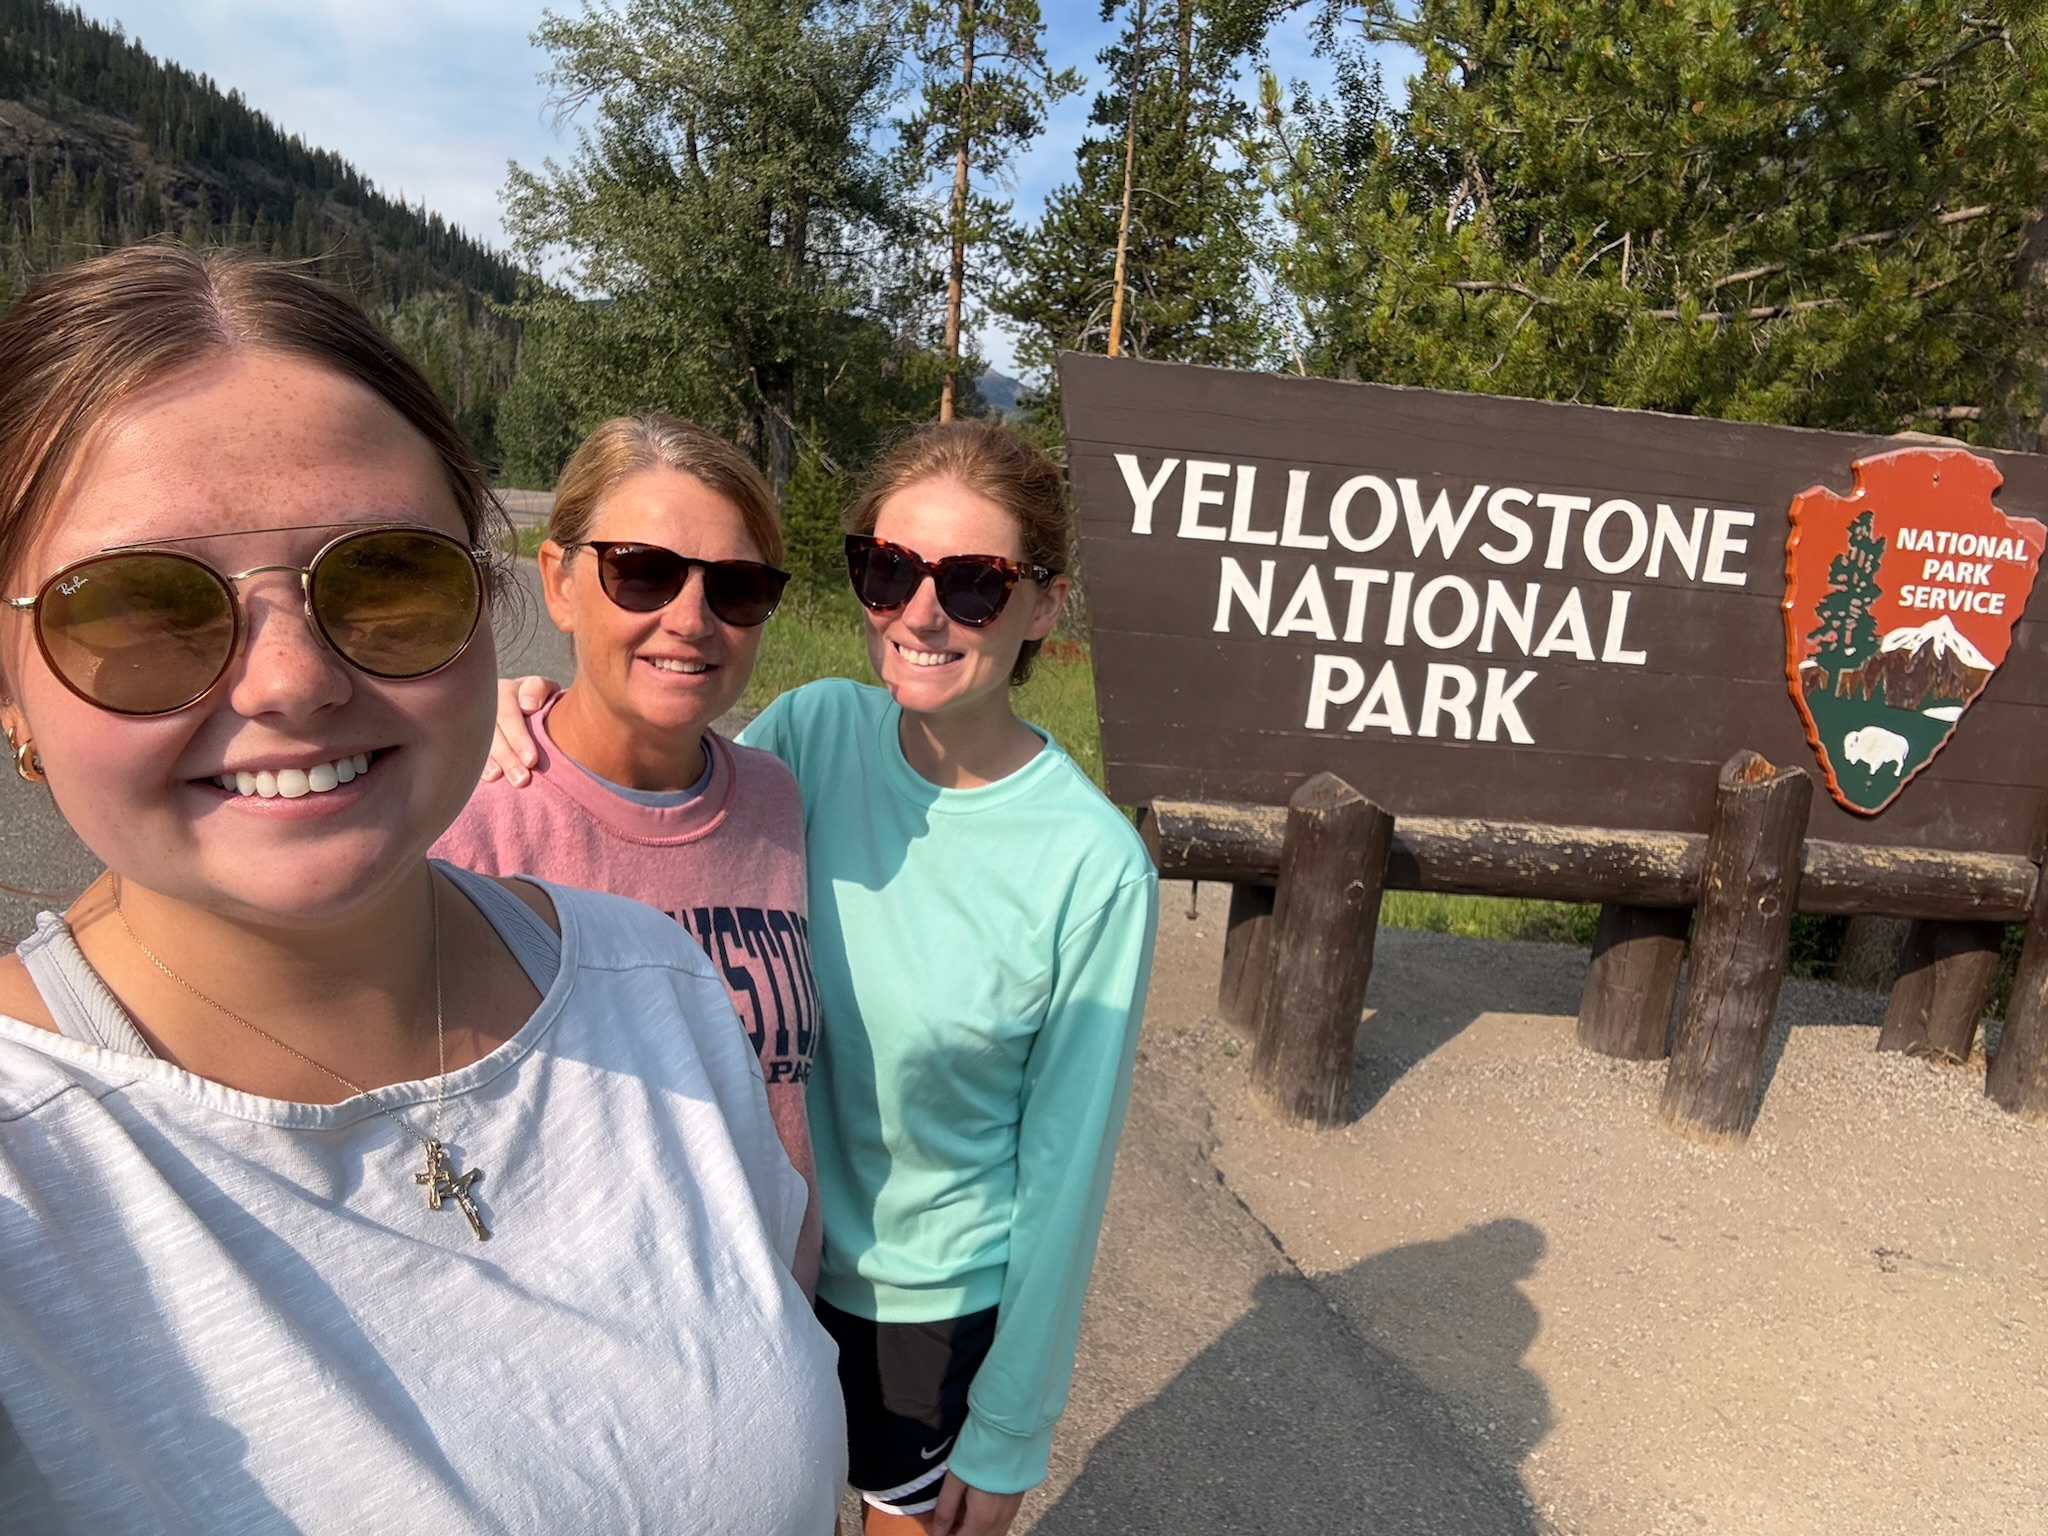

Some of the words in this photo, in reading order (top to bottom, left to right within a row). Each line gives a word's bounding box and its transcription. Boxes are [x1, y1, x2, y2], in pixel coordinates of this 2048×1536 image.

[1113, 453, 1756, 586] YELLOWSTONE
[1896, 527, 2029, 562] NATIONAL
[1898, 584, 2007, 615] SERVICE
[1922, 558, 1993, 585] PARK
[1212, 556, 1647, 665] NATIONAL
[1304, 654, 1539, 745] PARK
